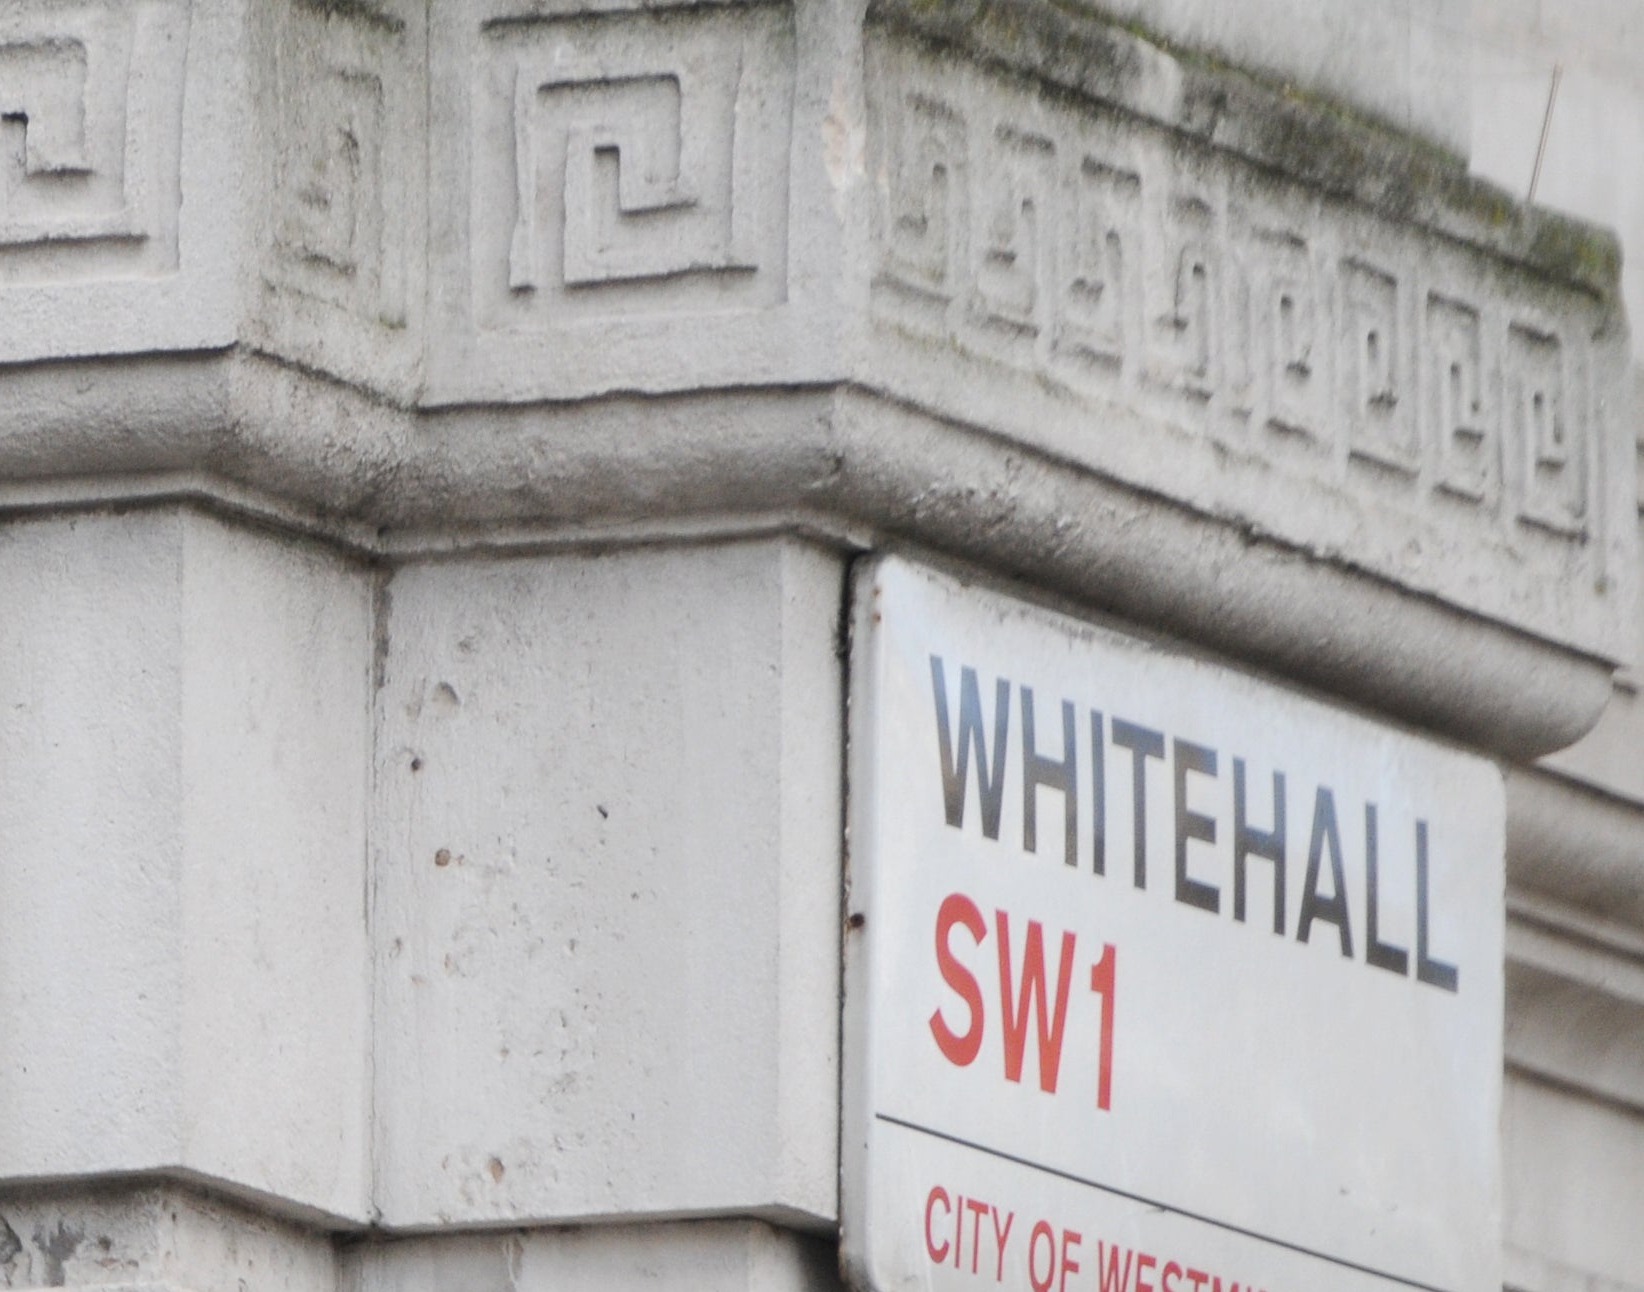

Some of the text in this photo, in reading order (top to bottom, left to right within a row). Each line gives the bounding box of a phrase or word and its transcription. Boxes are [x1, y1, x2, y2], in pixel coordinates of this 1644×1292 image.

[930, 654, 1459, 991] WHITEHALL
[930, 893, 1117, 1111] SW1
[926, 1187, 1014, 1279] CITY
